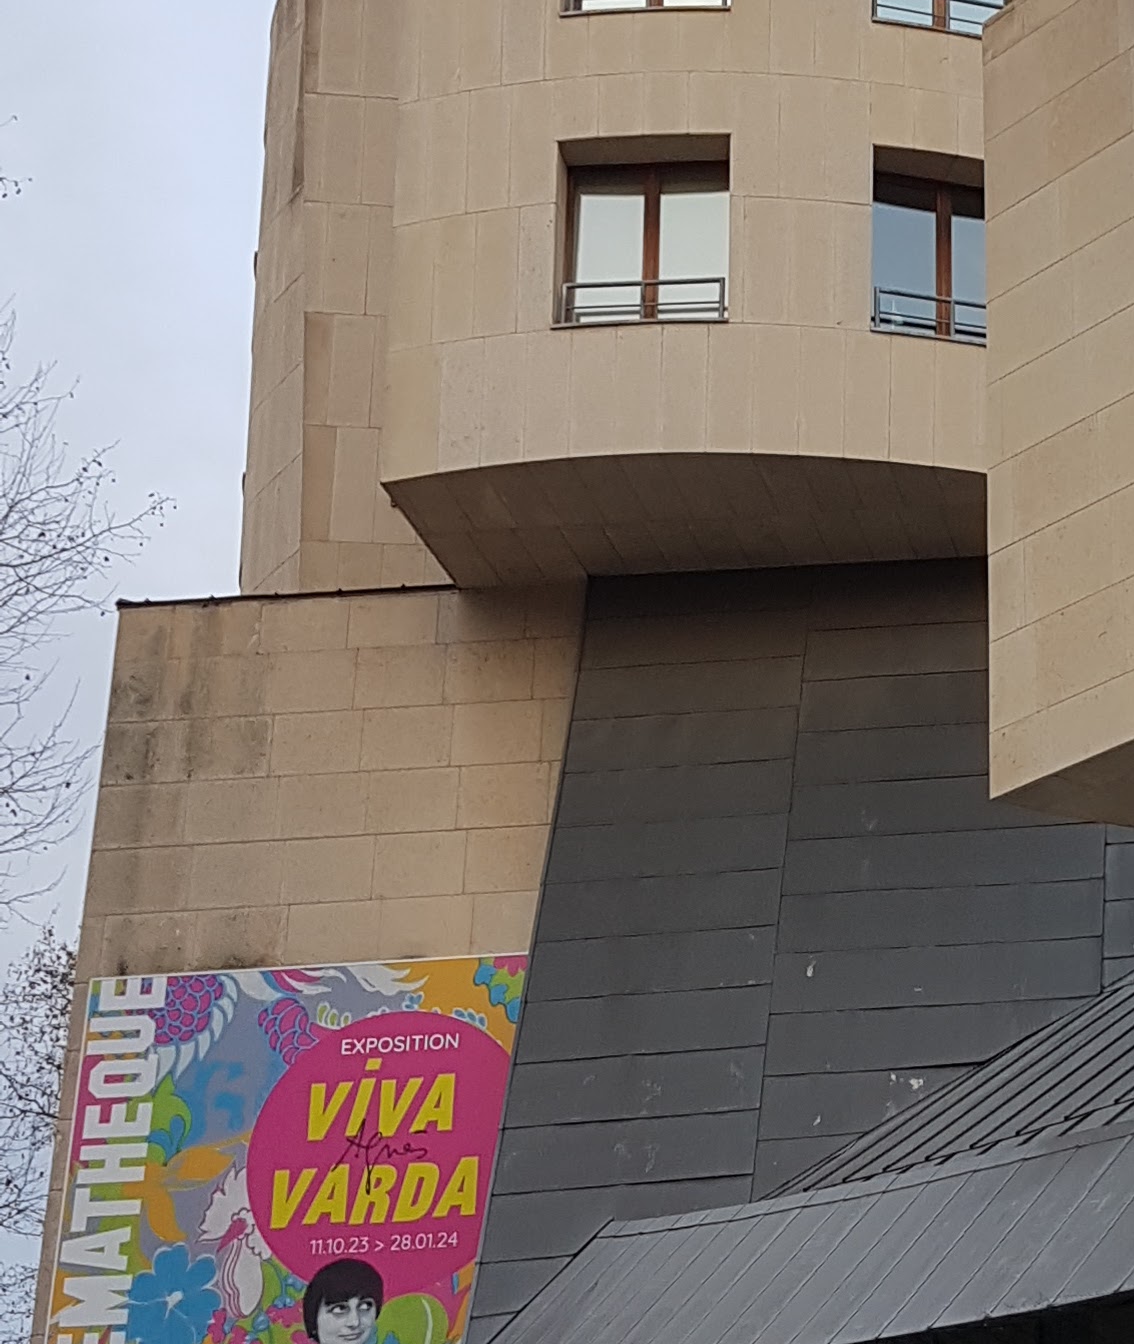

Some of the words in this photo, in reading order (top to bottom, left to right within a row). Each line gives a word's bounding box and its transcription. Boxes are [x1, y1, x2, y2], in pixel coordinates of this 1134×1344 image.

[341, 1033, 460, 1055] EXPOSITION
[270, 1156, 480, 1229] VARDA
[310, 1235, 370, 1255] 11.10.23
[390, 1231, 458, 1251] 28.01.24
